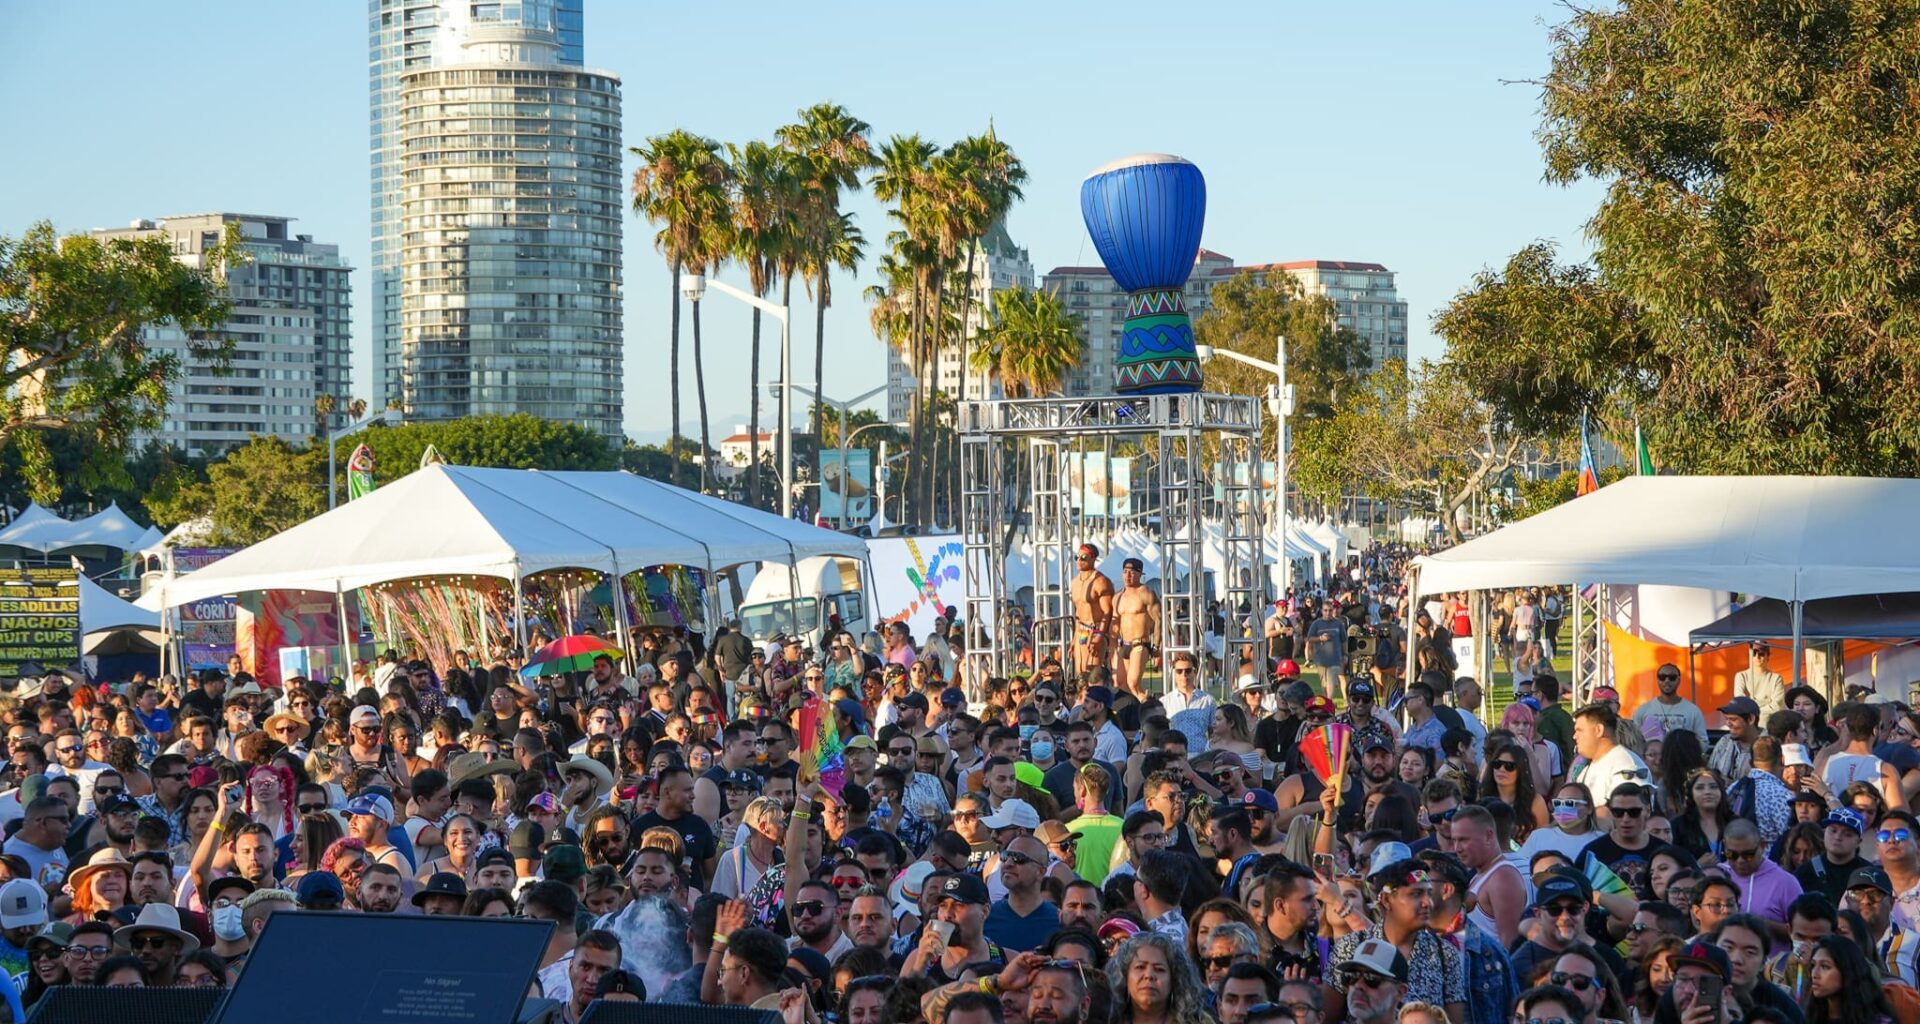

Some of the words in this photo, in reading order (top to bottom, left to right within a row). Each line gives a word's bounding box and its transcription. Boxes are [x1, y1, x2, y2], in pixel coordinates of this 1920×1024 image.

[195, 604, 226, 619] CORN
[1, 616, 79, 628] NACHOS
[34, 631, 74, 643] CUPS
